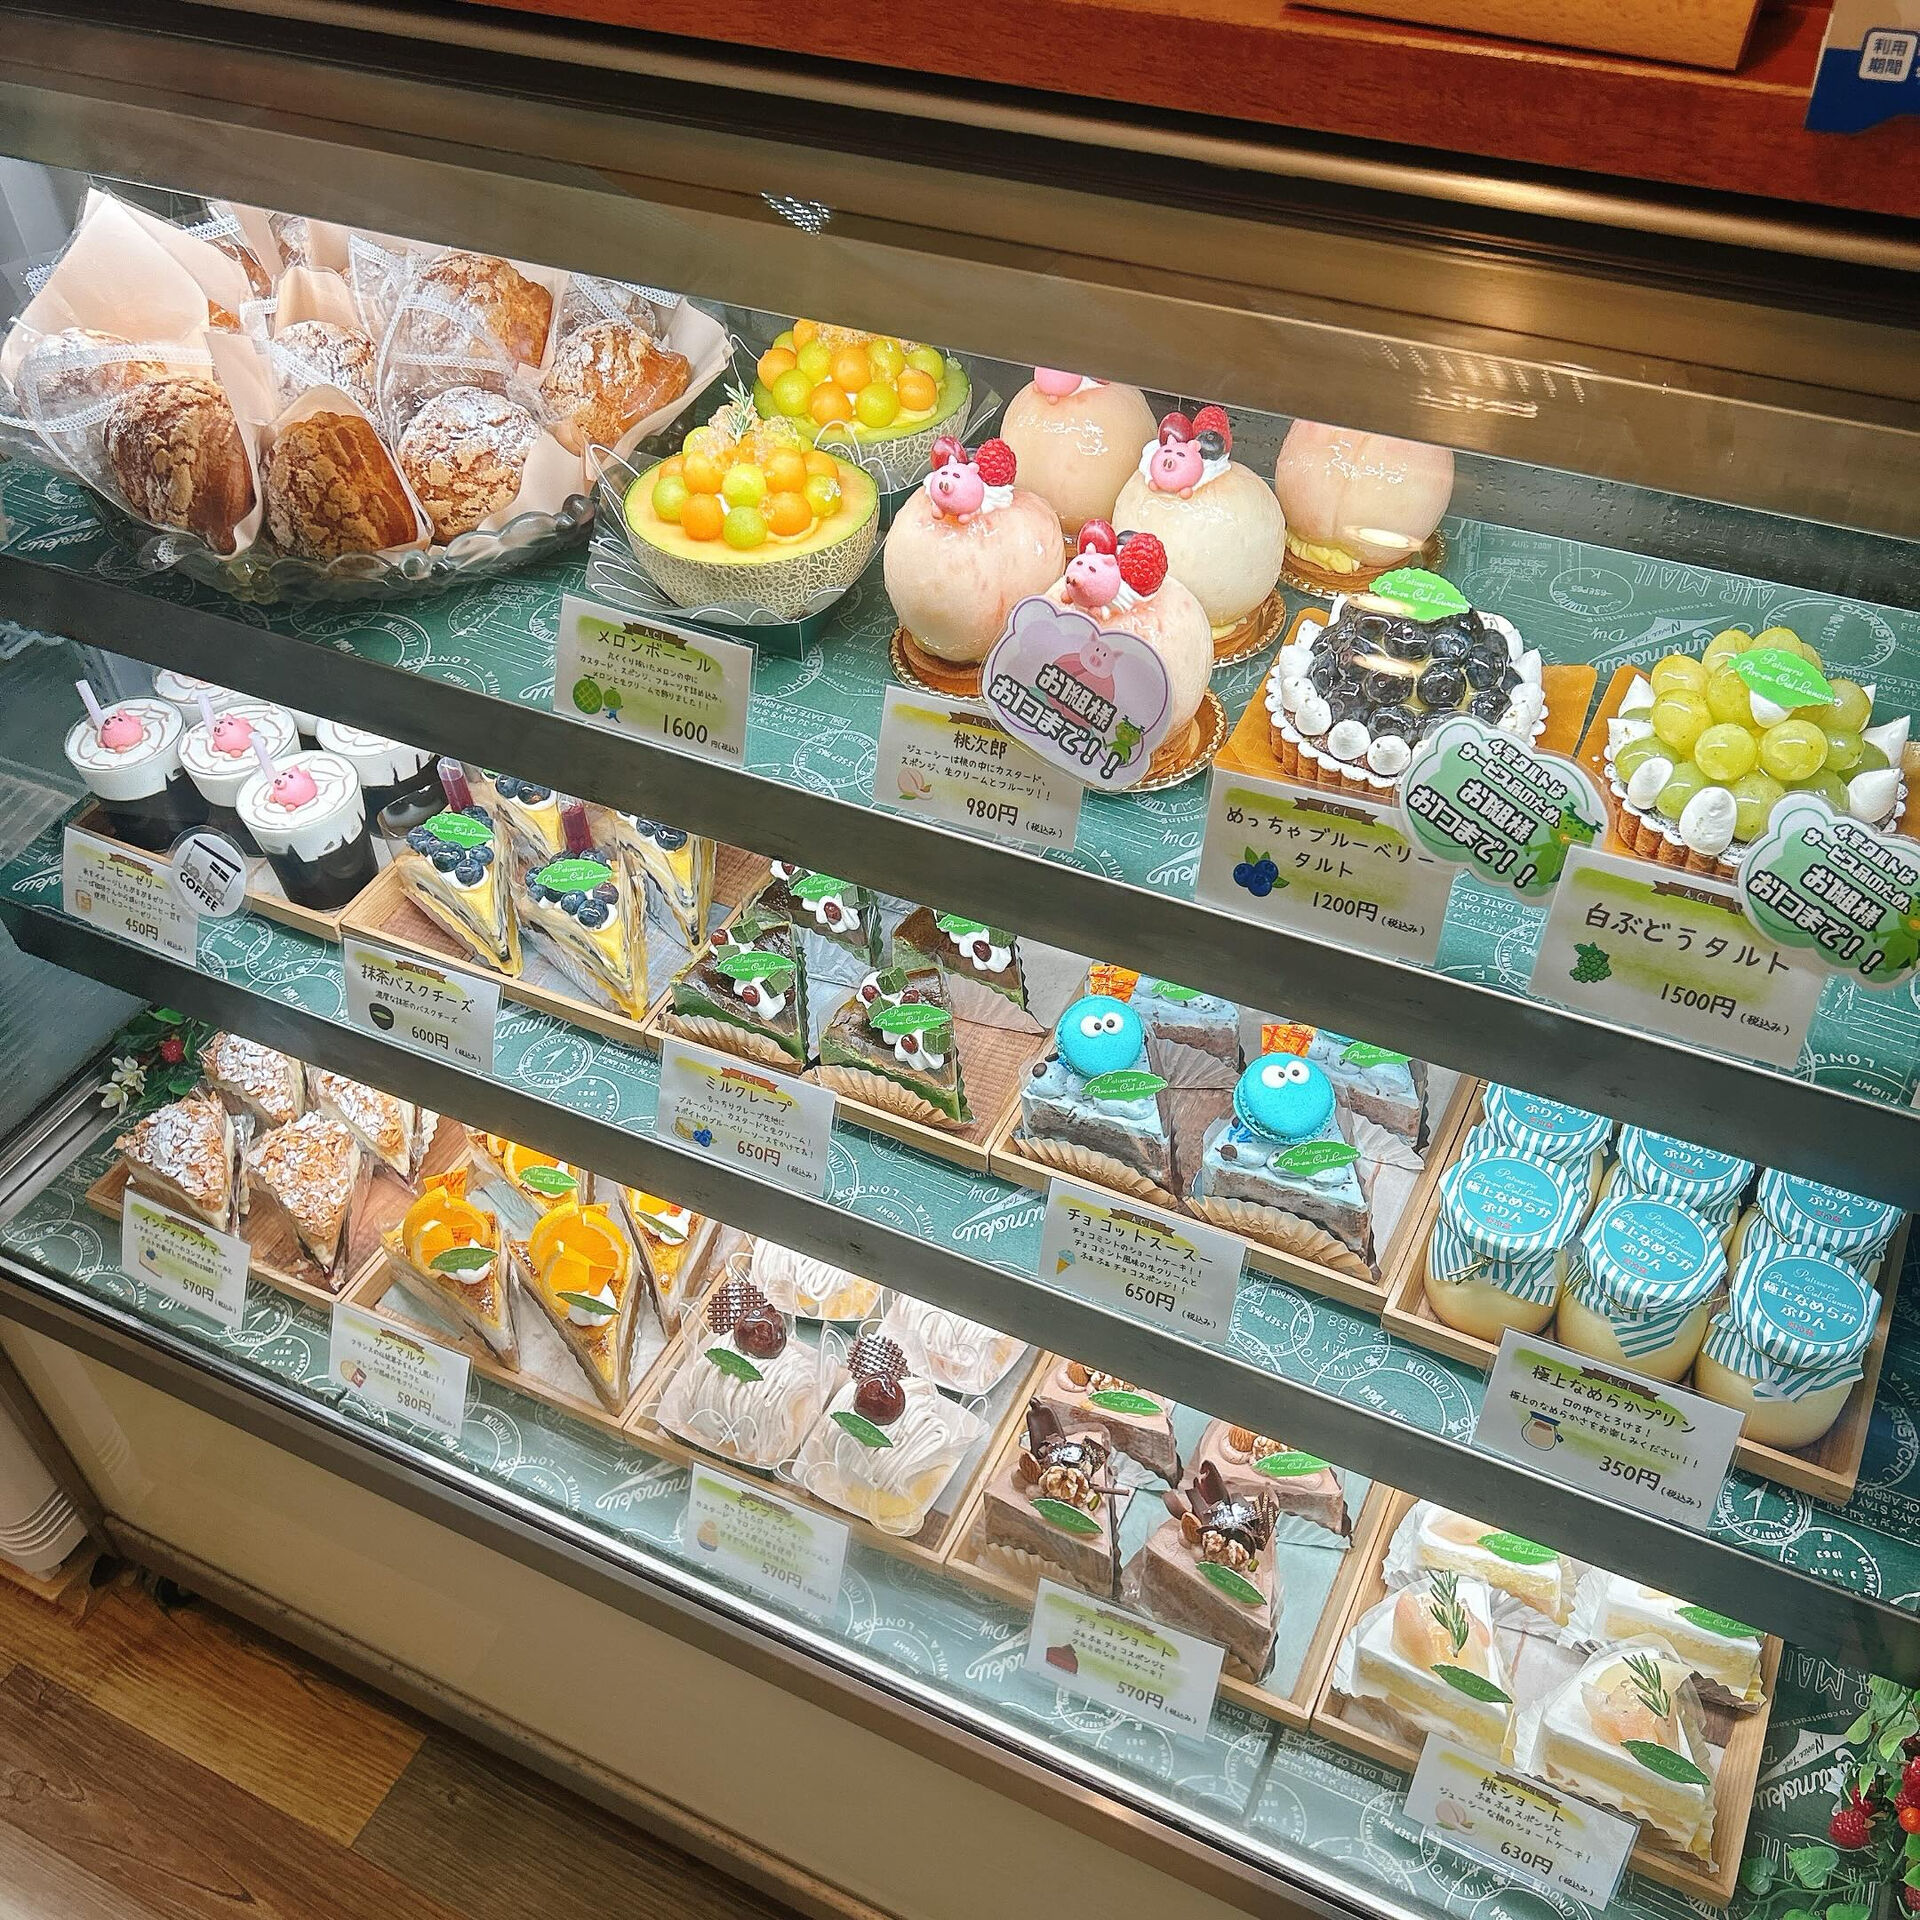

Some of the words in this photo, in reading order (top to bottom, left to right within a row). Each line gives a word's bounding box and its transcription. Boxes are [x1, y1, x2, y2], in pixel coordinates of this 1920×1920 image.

[1874, 39, 1908, 56] 利用
[1868, 58, 1902, 74] 期間
[663, 714, 707, 744] 1600
[953, 730, 1008, 759] 桃次郎
[901, 757, 1051, 801] スポンジ、生クリームとフルーツ！！
[1489, 739, 1567, 800] 4号タルトは
[966, 797, 1019, 826] 980円
[1226, 807, 1435, 864] めっちゃブルーベリー
[1295, 852, 1354, 878] タルト
[1834, 824, 1918, 886] 4号タルトは
[97, 860, 163, 890] コーヒーゼリー
[180, 872, 219, 912] COFFEE
[1312, 891, 1379, 922] 1200円
[125, 918, 159, 941] 450円
[1585, 902, 1790, 975] 白ぶどうタルト
[362, 963, 475, 1013] 抹茶バスクチーズ
[1660, 983, 1736, 1021] 1500円
[412, 1026, 449, 1049] 600円
[705, 1076, 792, 1113] ミルクレープ
[707, 1096, 785, 1126] もっちりクレープ生地に
[1524, 1103, 1565, 1124] ぷりん
[737, 1140, 781, 1167] 650円
[1663, 1148, 1706, 1170] ぷりん
[1465, 1180, 1552, 1219] 極上なめらか
[1480, 1201, 1523, 1224] ぷりん
[1808, 1195, 1853, 1218] ぷりん
[142, 1216, 226, 1257] インディアンサマー
[1067, 1208, 1213, 1264] チョコットスースー
[1610, 1218, 1694, 1271] 極上なめらか
[1074, 1239, 1197, 1286] チョコミント風味の生クリームと
[1620, 1242, 1661, 1271] ぷりん
[183, 1278, 213, 1302] 570円
[1125, 1283, 1175, 1312] 650円
[1762, 1280, 1856, 1325] 極上なめらか
[1780, 1304, 1826, 1330] ぷりん
[375, 1337, 425, 1365] サンマルク
[398, 1392, 432, 1416] 580円
[1532, 1365, 1696, 1434] 極上なめらかプリン
[1509, 1390, 1699, 1469] 極上のなめらかさをお楽しみください！！
[1563, 1398, 1651, 1438] 口の中でとろける！
[1599, 1455, 1661, 1491] 350円
[738, 1497, 795, 1528] モンブラン
[761, 1562, 802, 1589] 570円
[1074, 1614, 1172, 1658] チョコショート
[1117, 1681, 1164, 1710] 570円
[1480, 1777, 1564, 1824] 桃ショート
[1500, 1841, 1554, 1875] 630円
